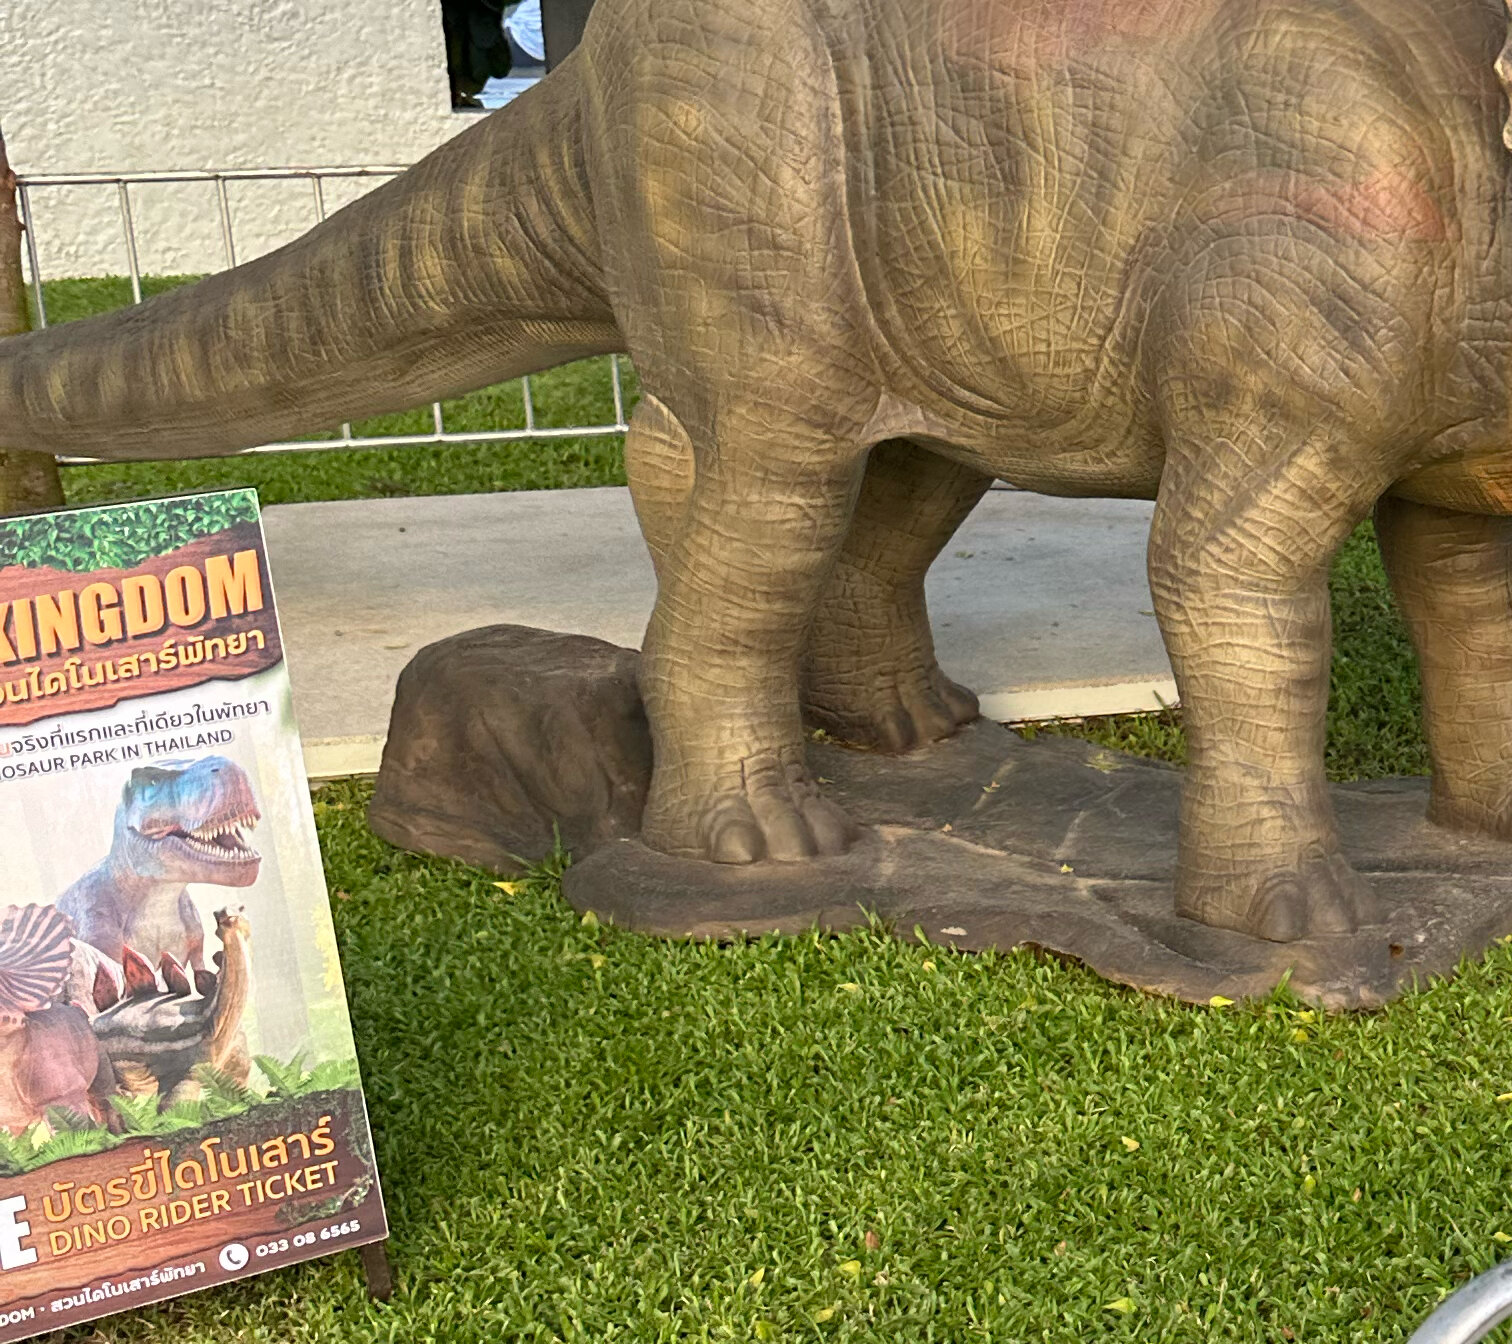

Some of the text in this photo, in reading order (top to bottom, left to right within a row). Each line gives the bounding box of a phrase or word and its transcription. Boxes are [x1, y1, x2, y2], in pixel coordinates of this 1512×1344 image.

[0, 729, 232, 780] OSAUR PARK IN THAILAND
[42, 1115, 336, 1223] บัตรขี่ไดโนเสาร์
[49, 1160, 339, 1256] DINO RIDER TICKET
[50, 1261, 206, 1312] สวนไดโนเสาร์พัทยา
[256, 1239, 289, 1257] 033
[293, 1232, 317, 1247] 08
[320, 1219, 361, 1240] 6565
